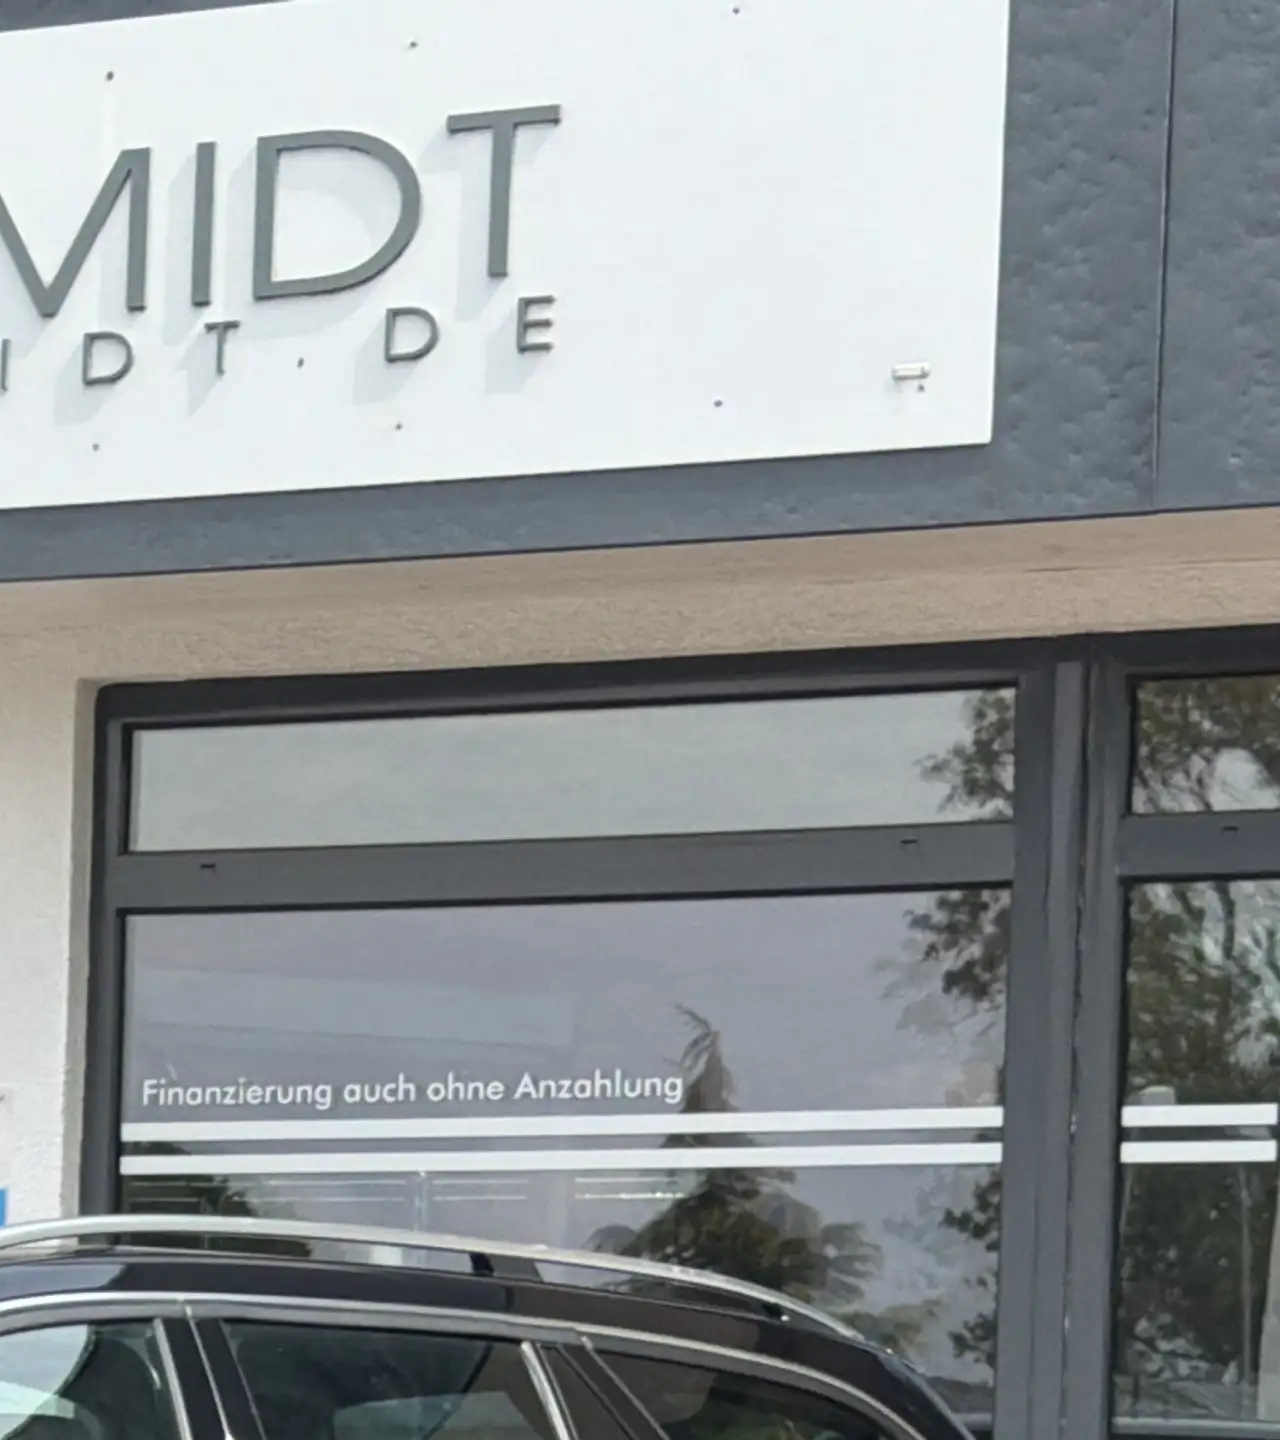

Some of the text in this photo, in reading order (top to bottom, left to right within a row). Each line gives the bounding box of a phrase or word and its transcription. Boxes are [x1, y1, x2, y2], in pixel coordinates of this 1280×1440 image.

[142, 1068, 684, 1112] Finanzierung auch ohne Anzahlung
